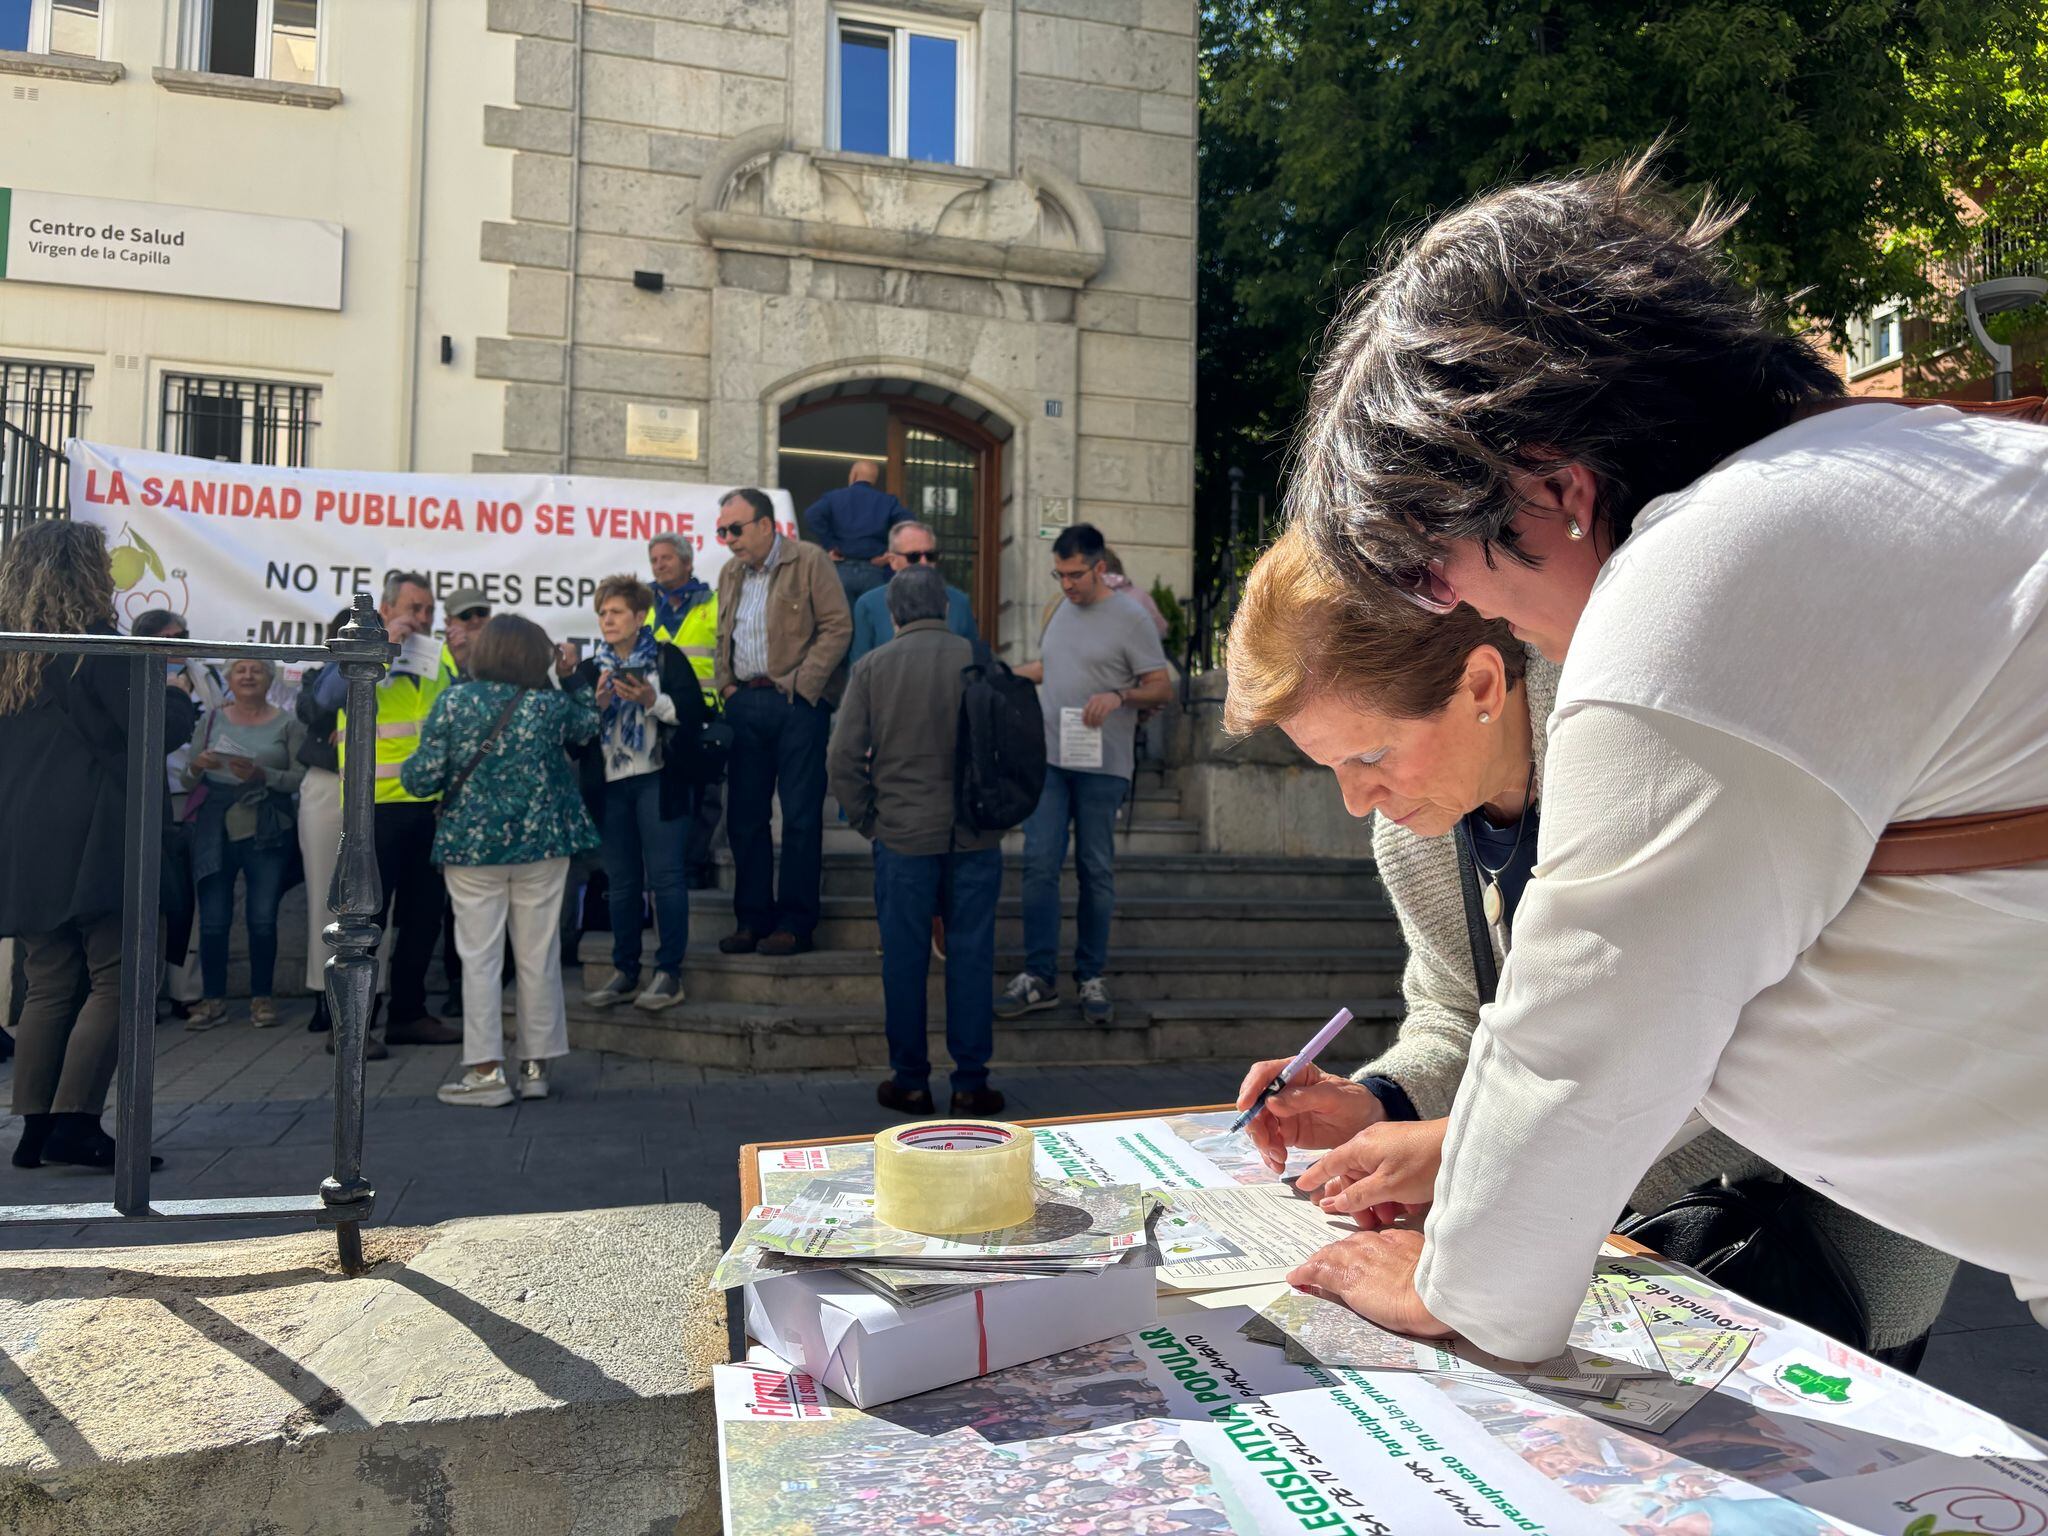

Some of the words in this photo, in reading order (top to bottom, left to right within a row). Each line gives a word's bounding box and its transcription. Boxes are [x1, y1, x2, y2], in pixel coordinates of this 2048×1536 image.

[29, 218, 96, 238] Centro
[101, 224, 125, 240] de
[130, 228, 185, 246] Salud
[29, 241, 76, 258] Virgen
[80, 245, 99, 258] de
[103, 247, 116, 260] la
[120, 249, 171, 265] Capilla
[85, 469, 130, 505] LA
[140, 477, 302, 520] SANIDAD
[315, 490, 463, 531] PUBLICA
[476, 501, 523, 534] NO
[534, 504, 575, 536] SE
[586, 507, 704, 551] VENDE,
[265, 561, 318, 593] NO
[330, 566, 371, 596] TE
[1645, 1283, 1670, 1295] de
[1139, 1327, 1231, 1403] POPULAR
[1185, 1335, 1261, 1397] PARLAMENTO
[745, 1373, 793, 1417] Firma
[801, 1395, 818, 1403] tu
[804, 1405, 826, 1416] por
[1251, 1400, 1280, 1418] AL
[1383, 1404, 1408, 1420] las
[1330, 1389, 1410, 1458] Participación
[1400, 1419, 1423, 1433] de
[1268, 1423, 1322, 1465] SALUD
[1416, 1434, 1444, 1452] Fin
[1308, 1470, 1339, 1484] TU
[1404, 1461, 1445, 1483] POR
[1328, 1487, 1365, 1507] DE
[1441, 1456, 1545, 1531] presupuesto
[1434, 1488, 1501, 1528] FIRMA
